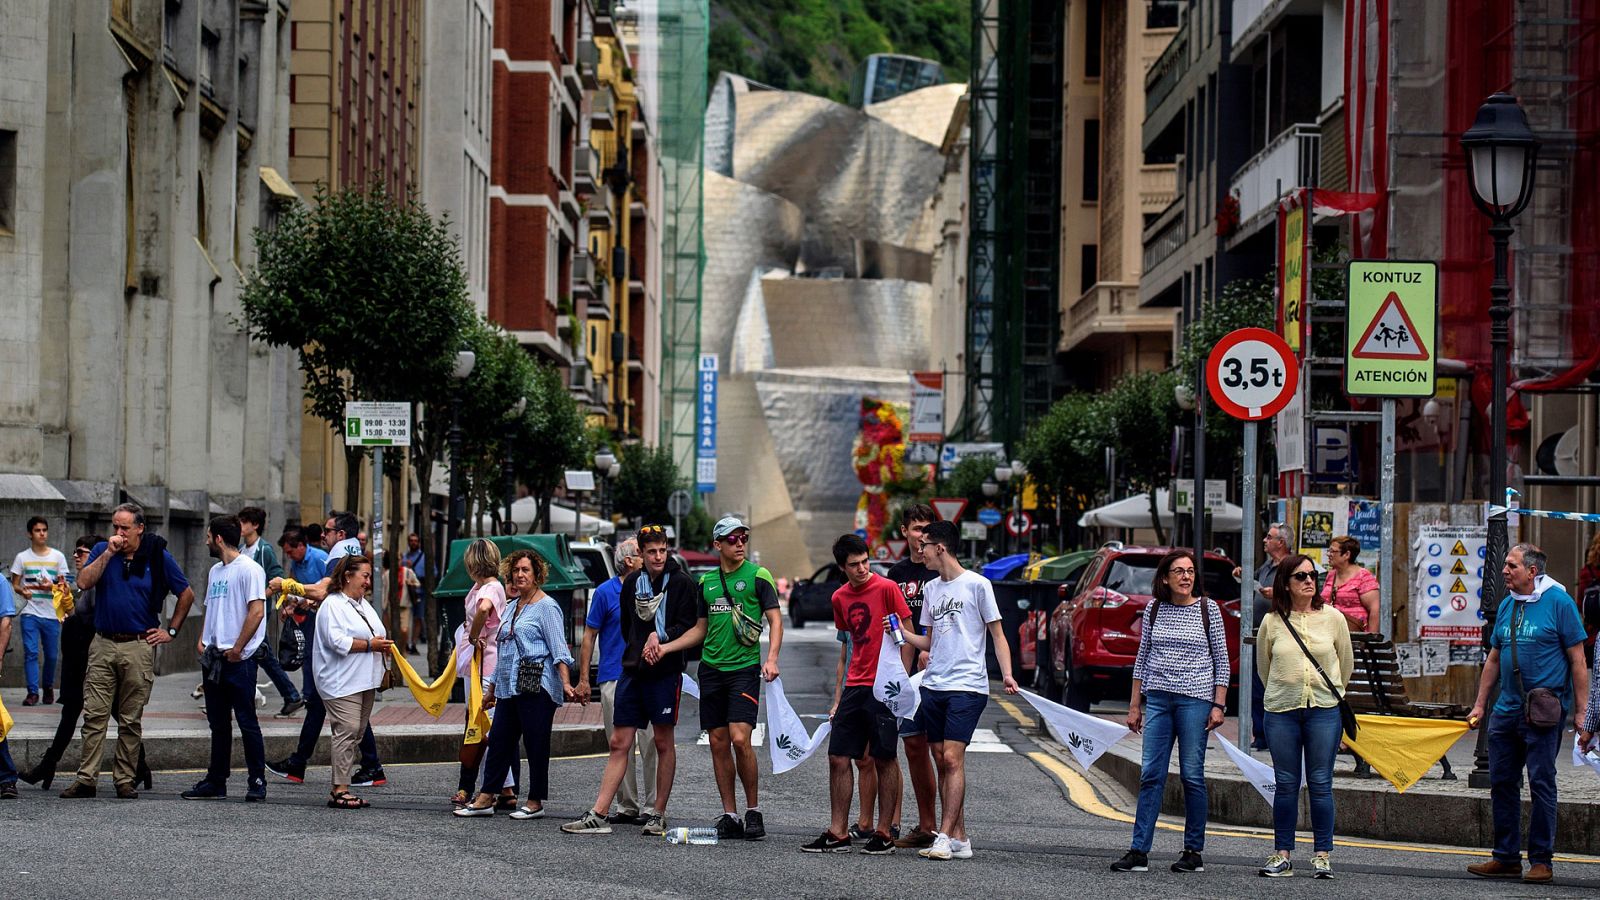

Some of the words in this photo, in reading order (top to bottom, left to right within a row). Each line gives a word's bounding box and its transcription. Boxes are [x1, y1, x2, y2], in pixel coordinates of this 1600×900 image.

[1363, 271, 1423, 284] KONTUZ
[1354, 369, 1428, 382] ATENCIÓN
[702, 372, 714, 448] HORLASA
[350, 422, 356, 434] 1
[1316, 428, 1350, 474] P
